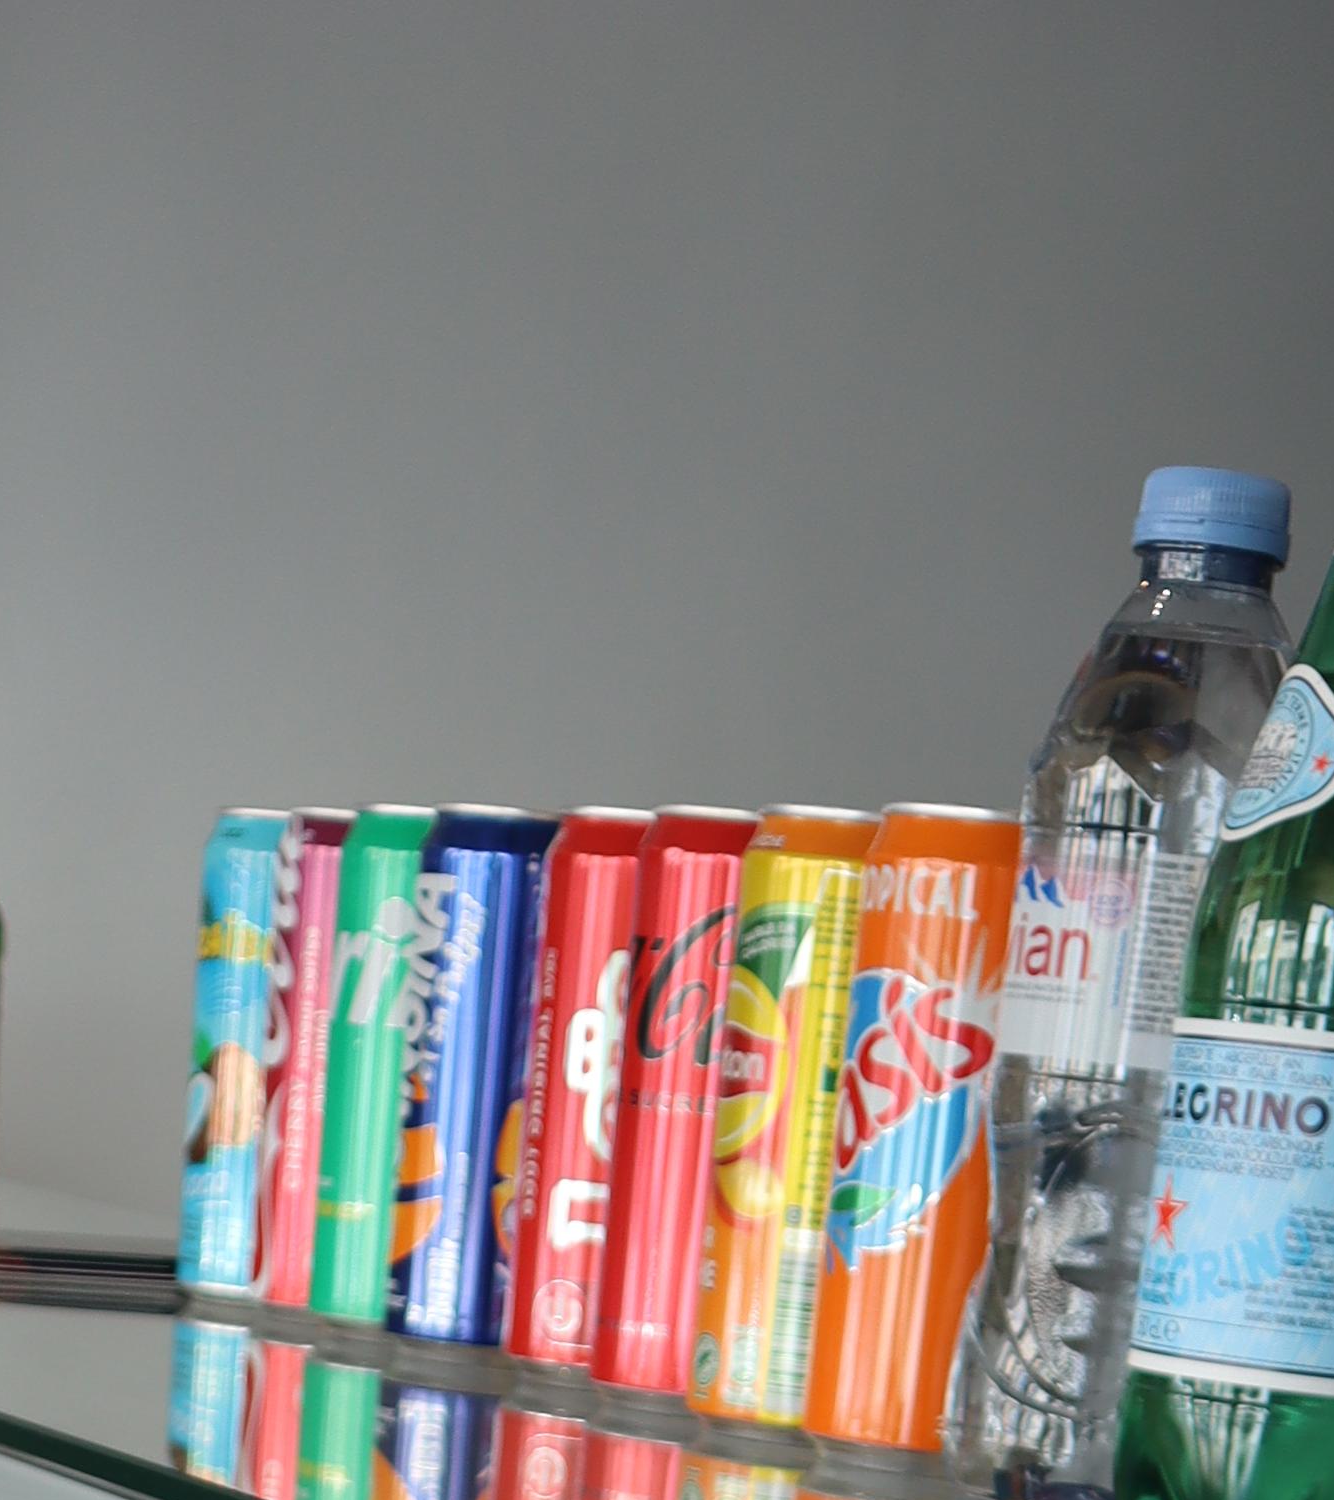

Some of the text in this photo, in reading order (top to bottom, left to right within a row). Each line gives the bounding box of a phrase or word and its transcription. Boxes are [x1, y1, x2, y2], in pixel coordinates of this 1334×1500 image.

[862, 864, 979, 921] OPICAL
[1014, 912, 1091, 981] ian
[836, 974, 995, 1170] asis
[1164, 1082, 1331, 1136] EGRINO
